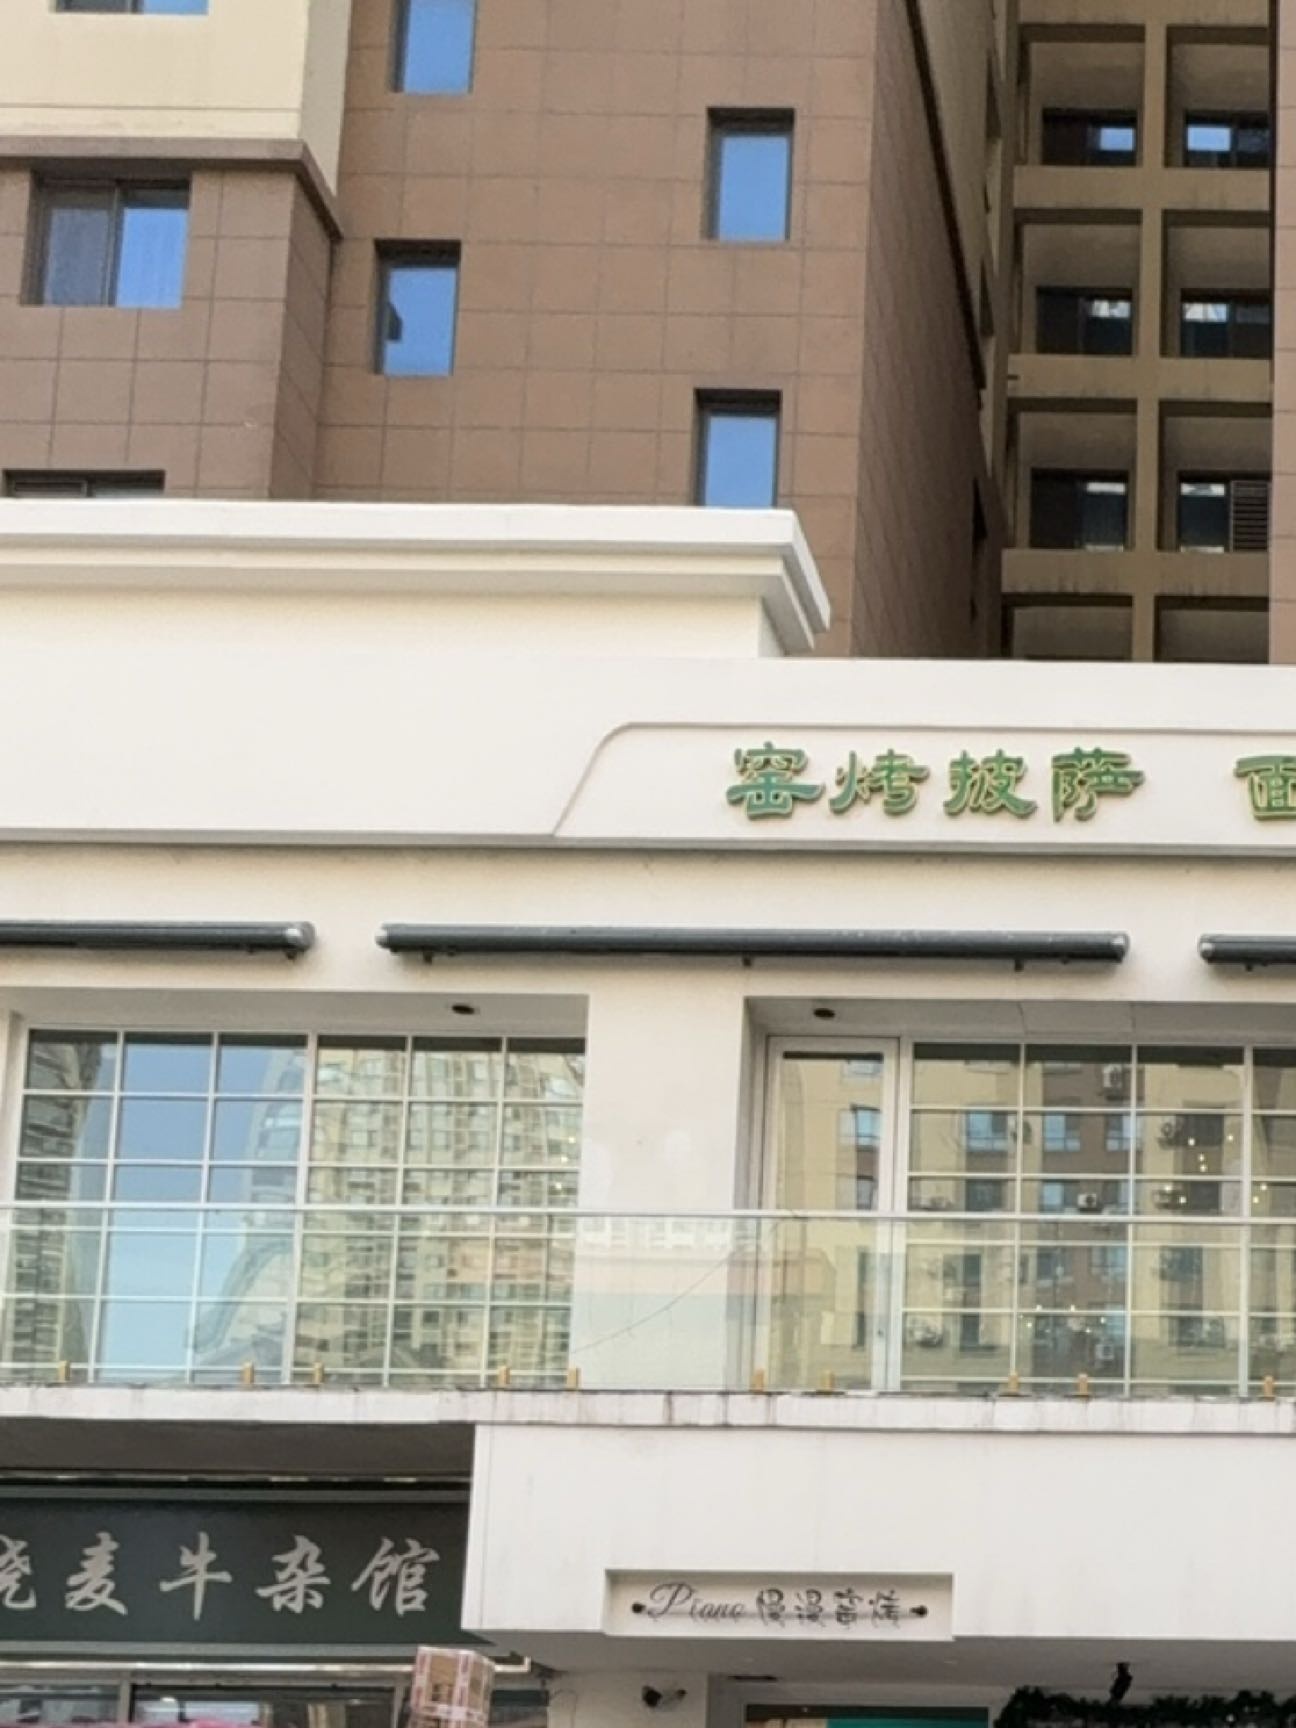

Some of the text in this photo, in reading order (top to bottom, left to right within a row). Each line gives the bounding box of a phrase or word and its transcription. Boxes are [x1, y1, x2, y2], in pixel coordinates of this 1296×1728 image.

[726, 742, 1145, 824] 窑烤披萨
[647, 1582, 746, 1620] Piano
